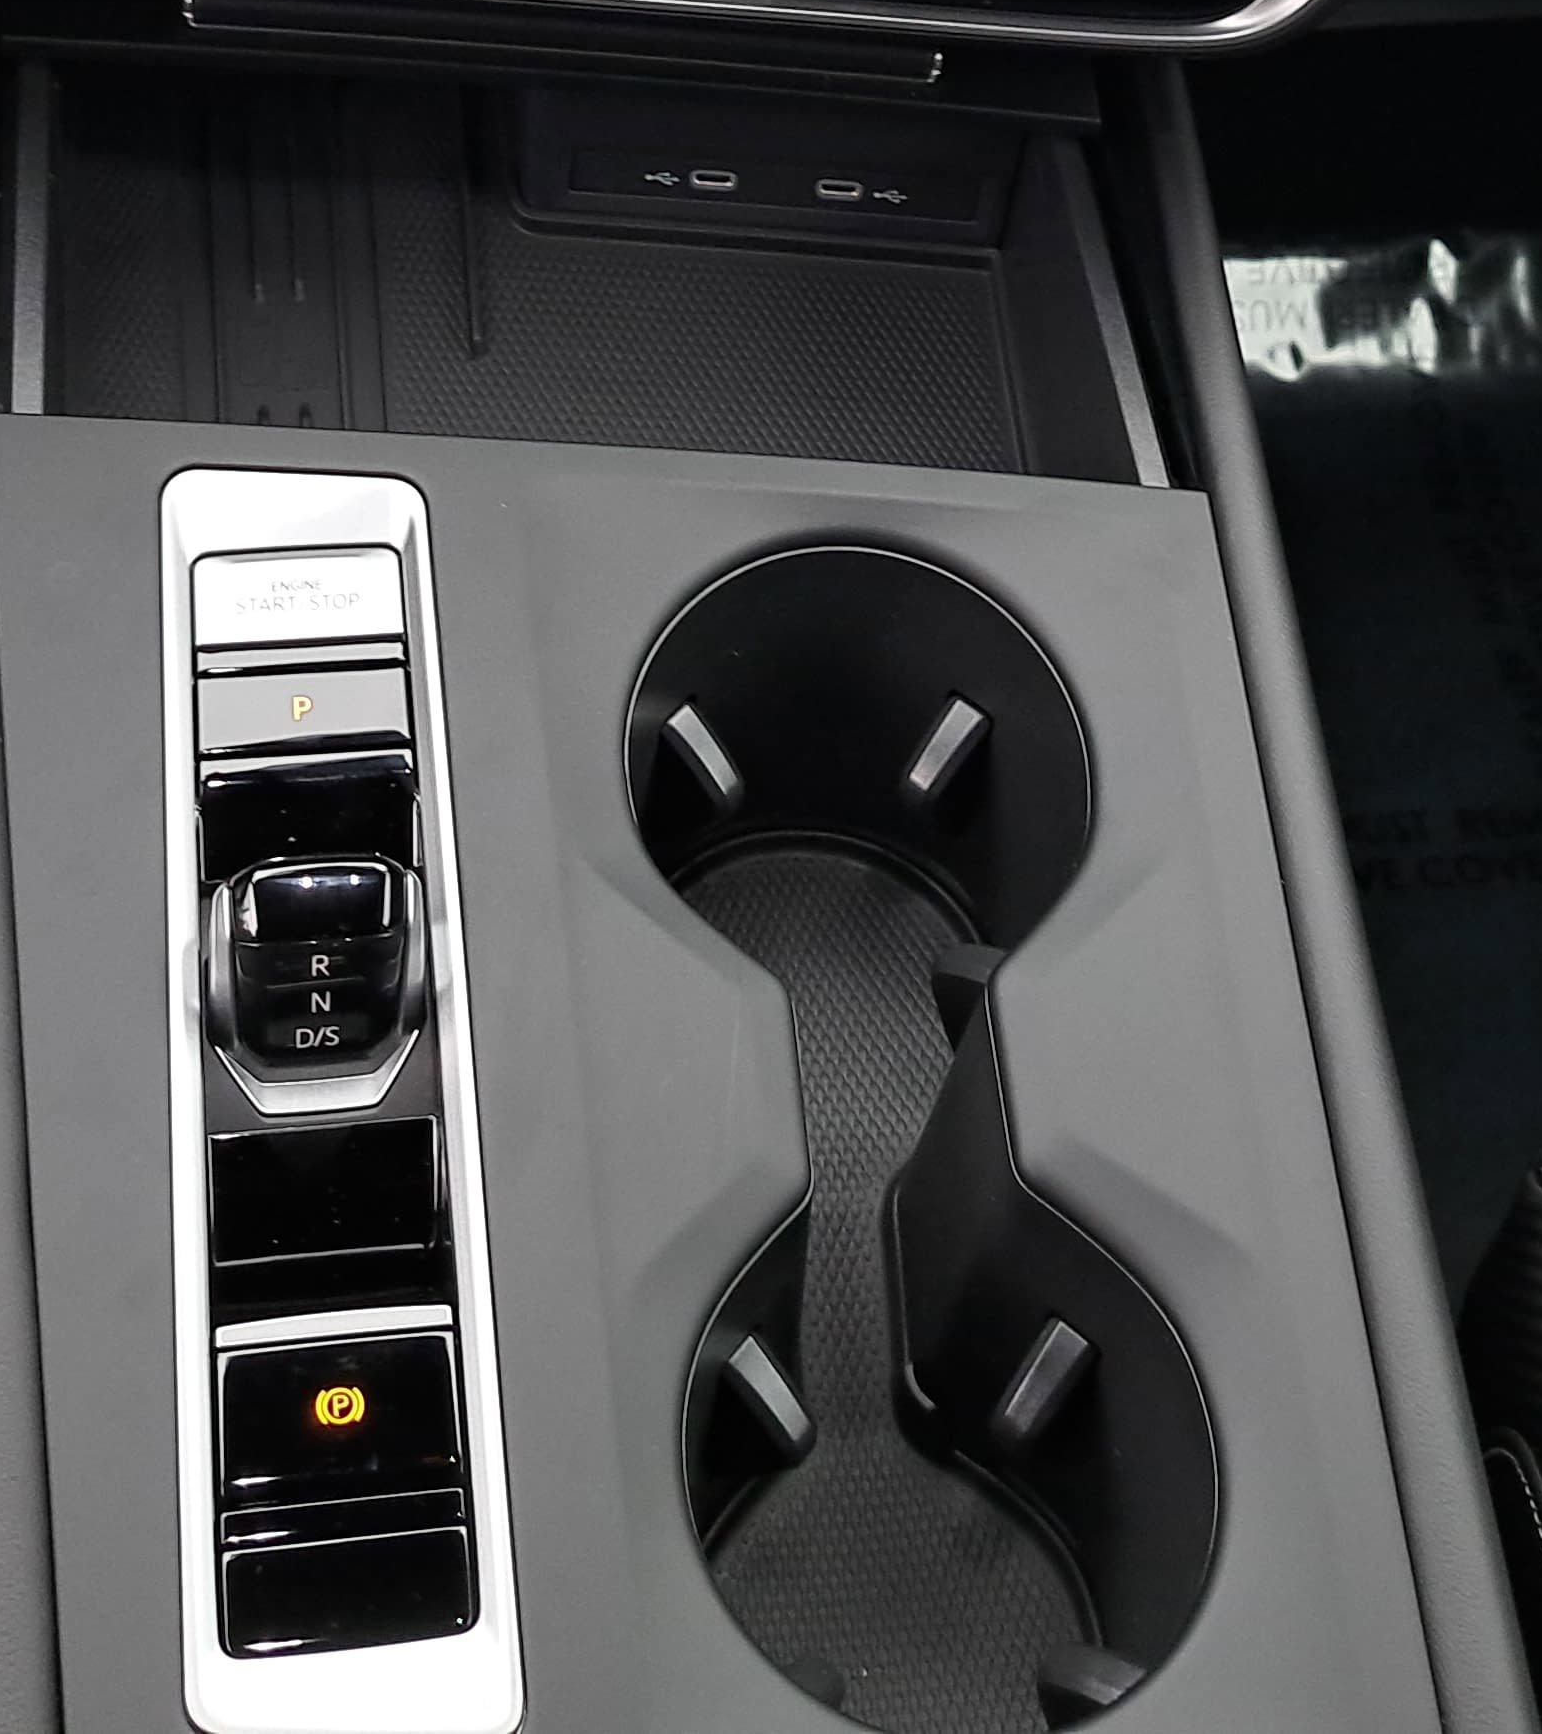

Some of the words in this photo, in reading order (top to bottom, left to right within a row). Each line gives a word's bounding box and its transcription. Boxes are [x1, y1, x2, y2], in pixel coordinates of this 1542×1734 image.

[290, 695, 313, 722] P
[310, 954, 330, 977] R
[310, 991, 332, 1014] N
[294, 1025, 341, 1050] D/S
